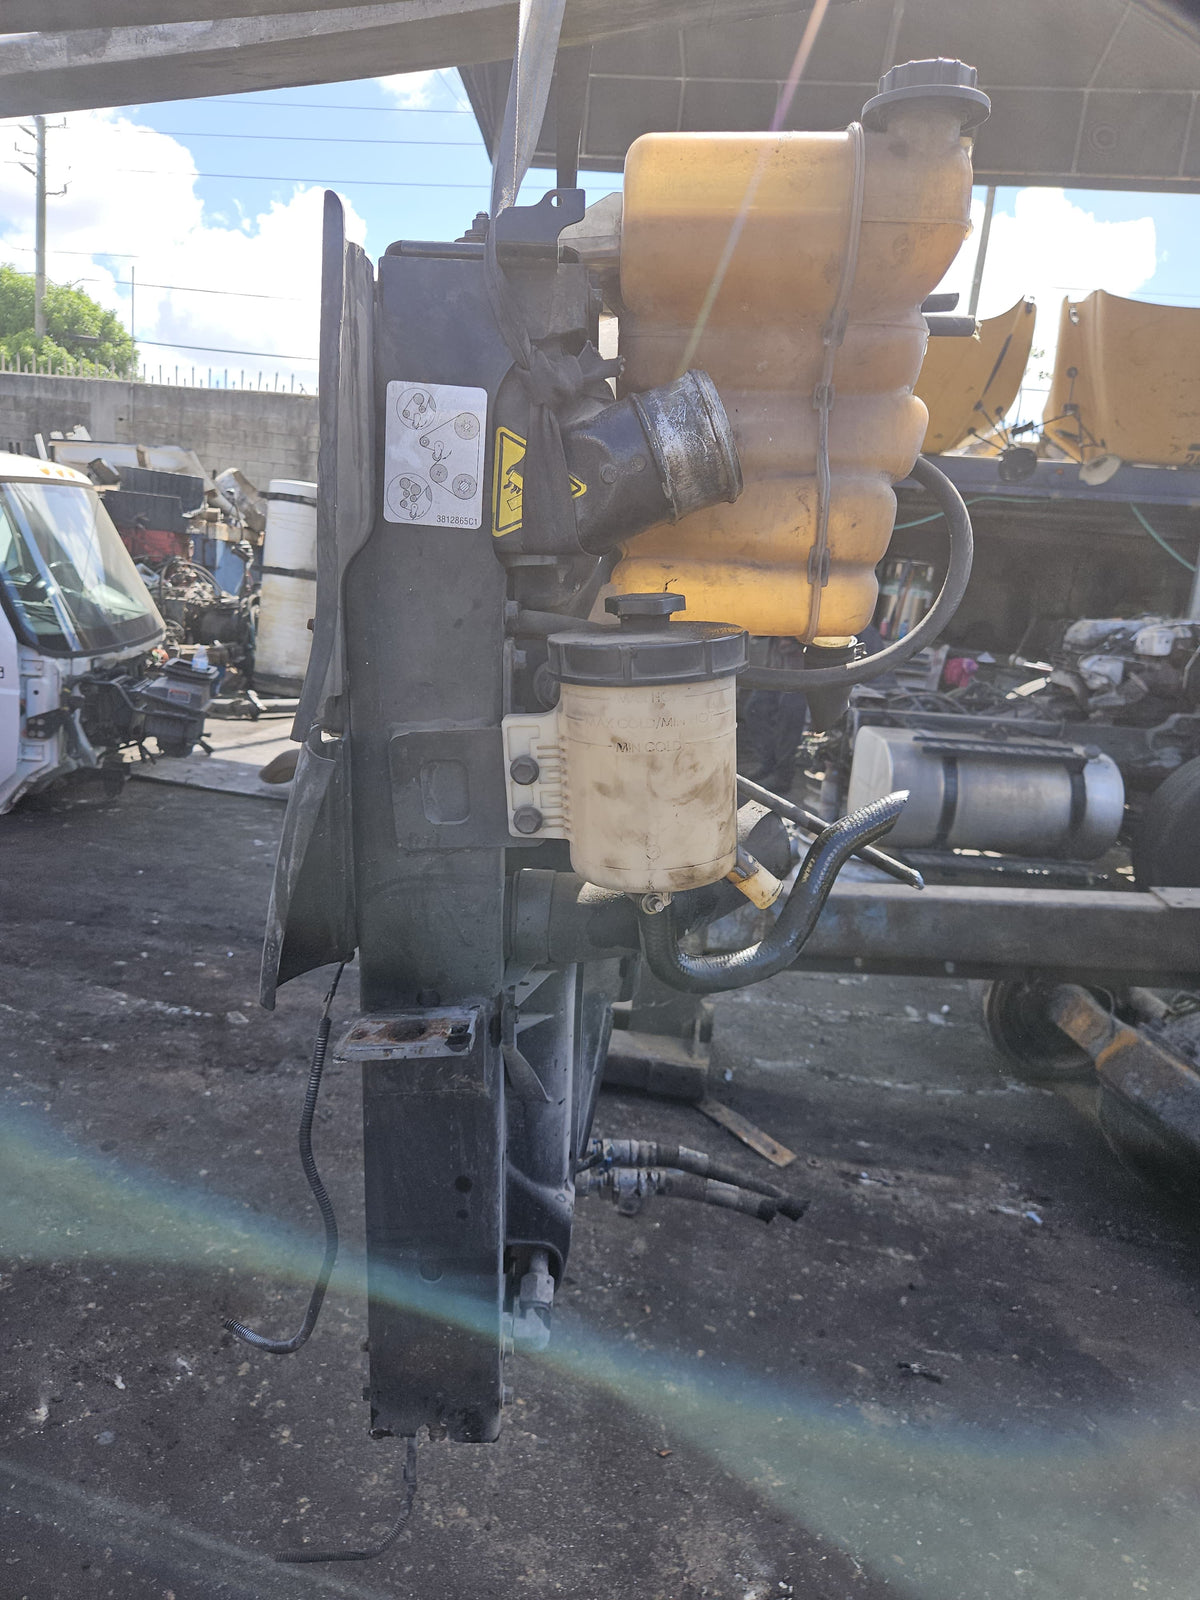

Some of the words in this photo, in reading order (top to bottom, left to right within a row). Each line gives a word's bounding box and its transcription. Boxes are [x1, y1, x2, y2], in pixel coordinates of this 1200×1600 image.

[436, 514, 478, 526] 3812865C1
[615, 741, 641, 753] MIN
[645, 741, 682, 753] COLD
